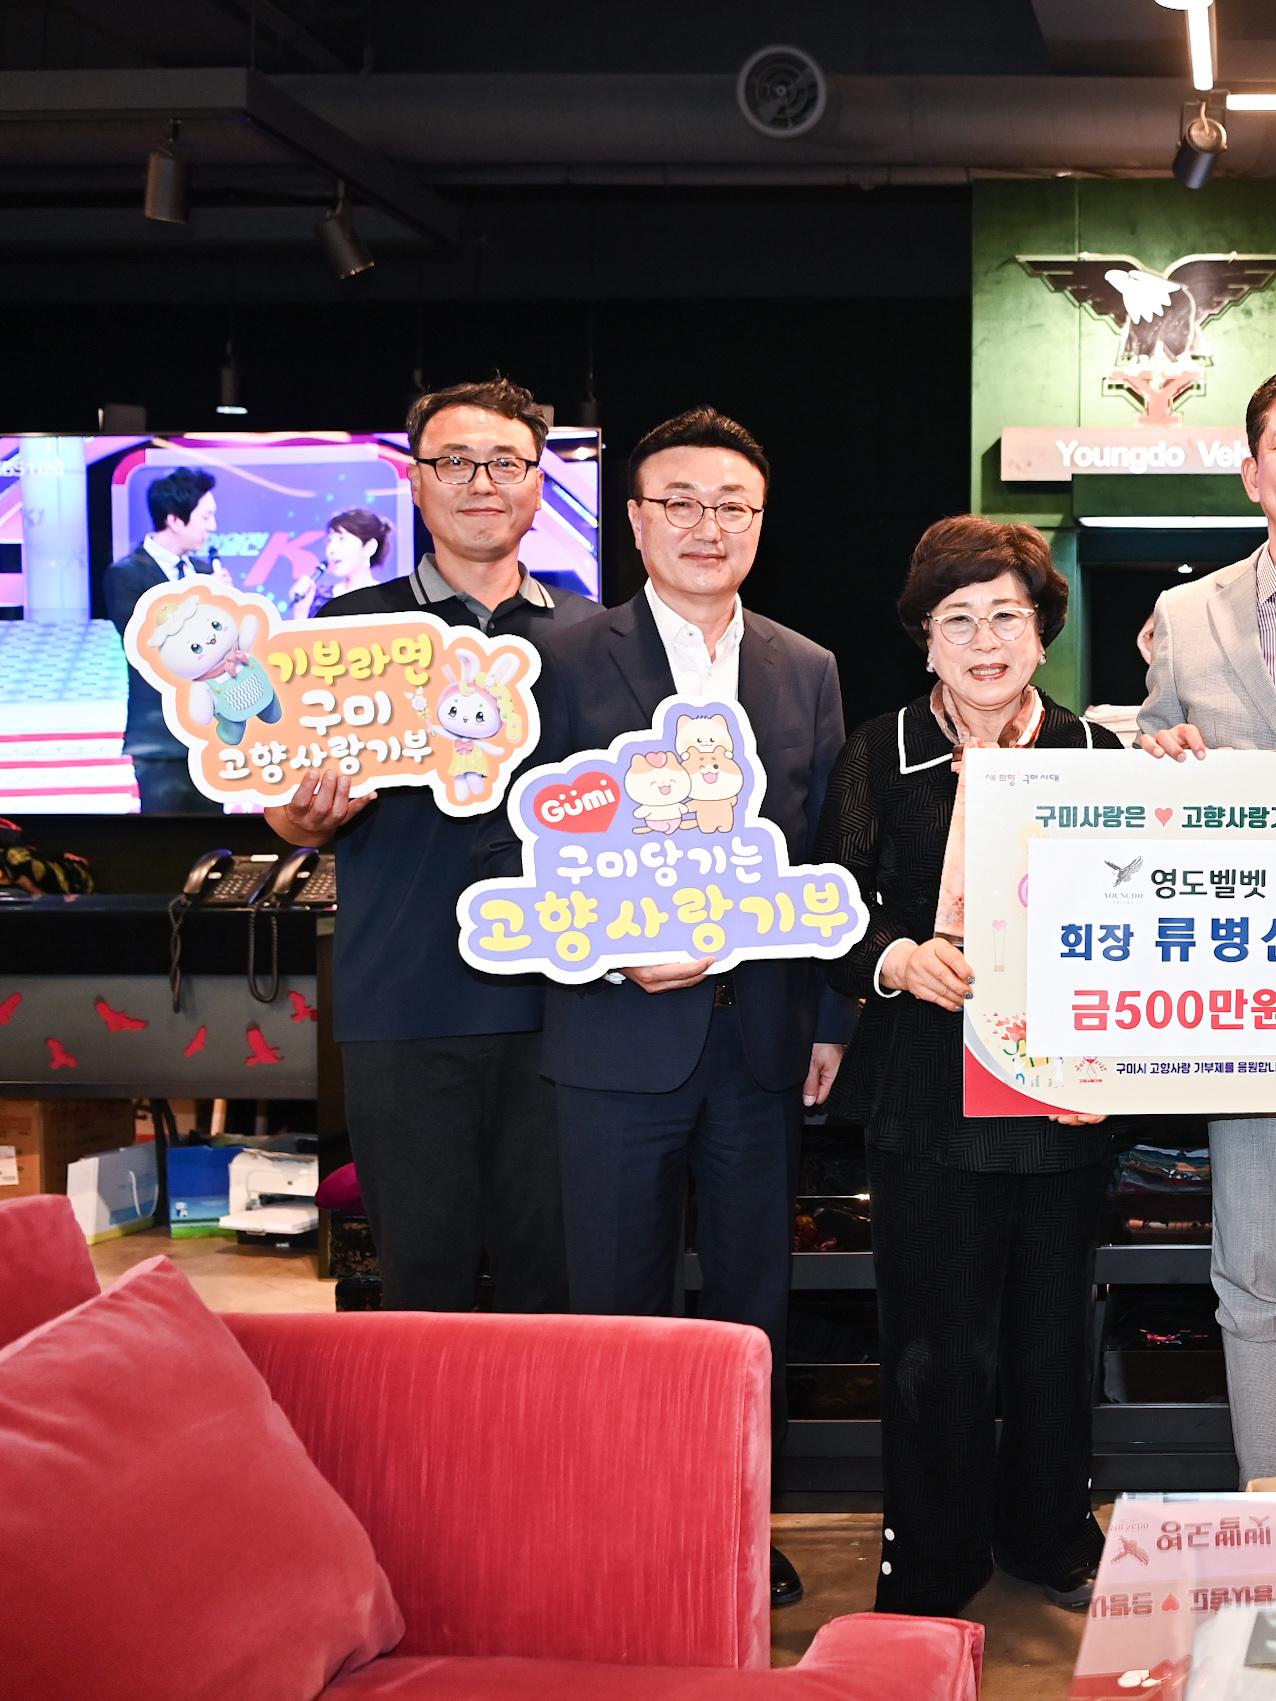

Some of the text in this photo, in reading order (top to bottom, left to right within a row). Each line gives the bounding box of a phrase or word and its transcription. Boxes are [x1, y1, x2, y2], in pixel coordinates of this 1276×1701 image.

[1055, 440, 1186, 474] Youngdo
[267, 633, 433, 686] 기부라면
[299, 689, 392, 737] 구미
[218, 729, 433, 784] 고향사랑기부
[1035, 805, 1147, 829] 구미사랑은
[556, 836, 763, 887] 구미당기는
[1151, 868, 1267, 900] 영도벨벳
[479, 882, 849, 961] 고향사랑기부
[1060, 922, 1134, 962] 회장
[1116, 1062, 1147, 1075] 구미시
[1150, 1062, 1191, 1074] 고향사랑
[1194, 1062, 1235, 1074] 기부제를
